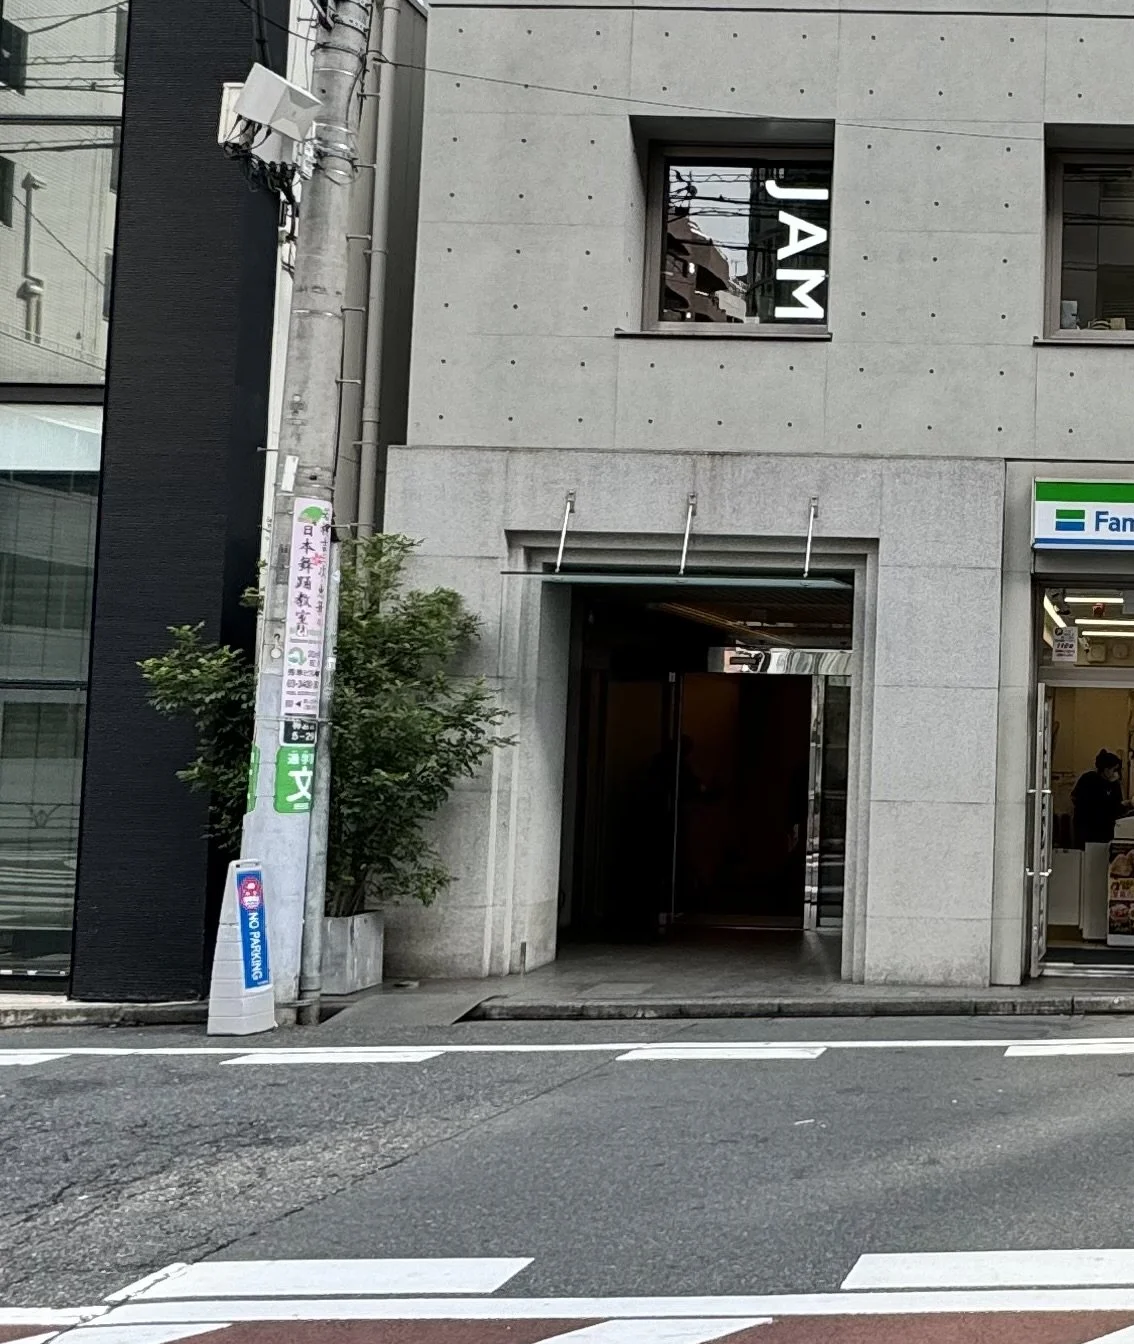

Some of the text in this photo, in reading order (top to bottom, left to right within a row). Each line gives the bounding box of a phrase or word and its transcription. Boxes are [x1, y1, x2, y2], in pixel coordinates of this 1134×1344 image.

[765, 178, 829, 320] JAM
[247, 912, 260, 930] NO
[249, 930, 263, 980] PARKING
